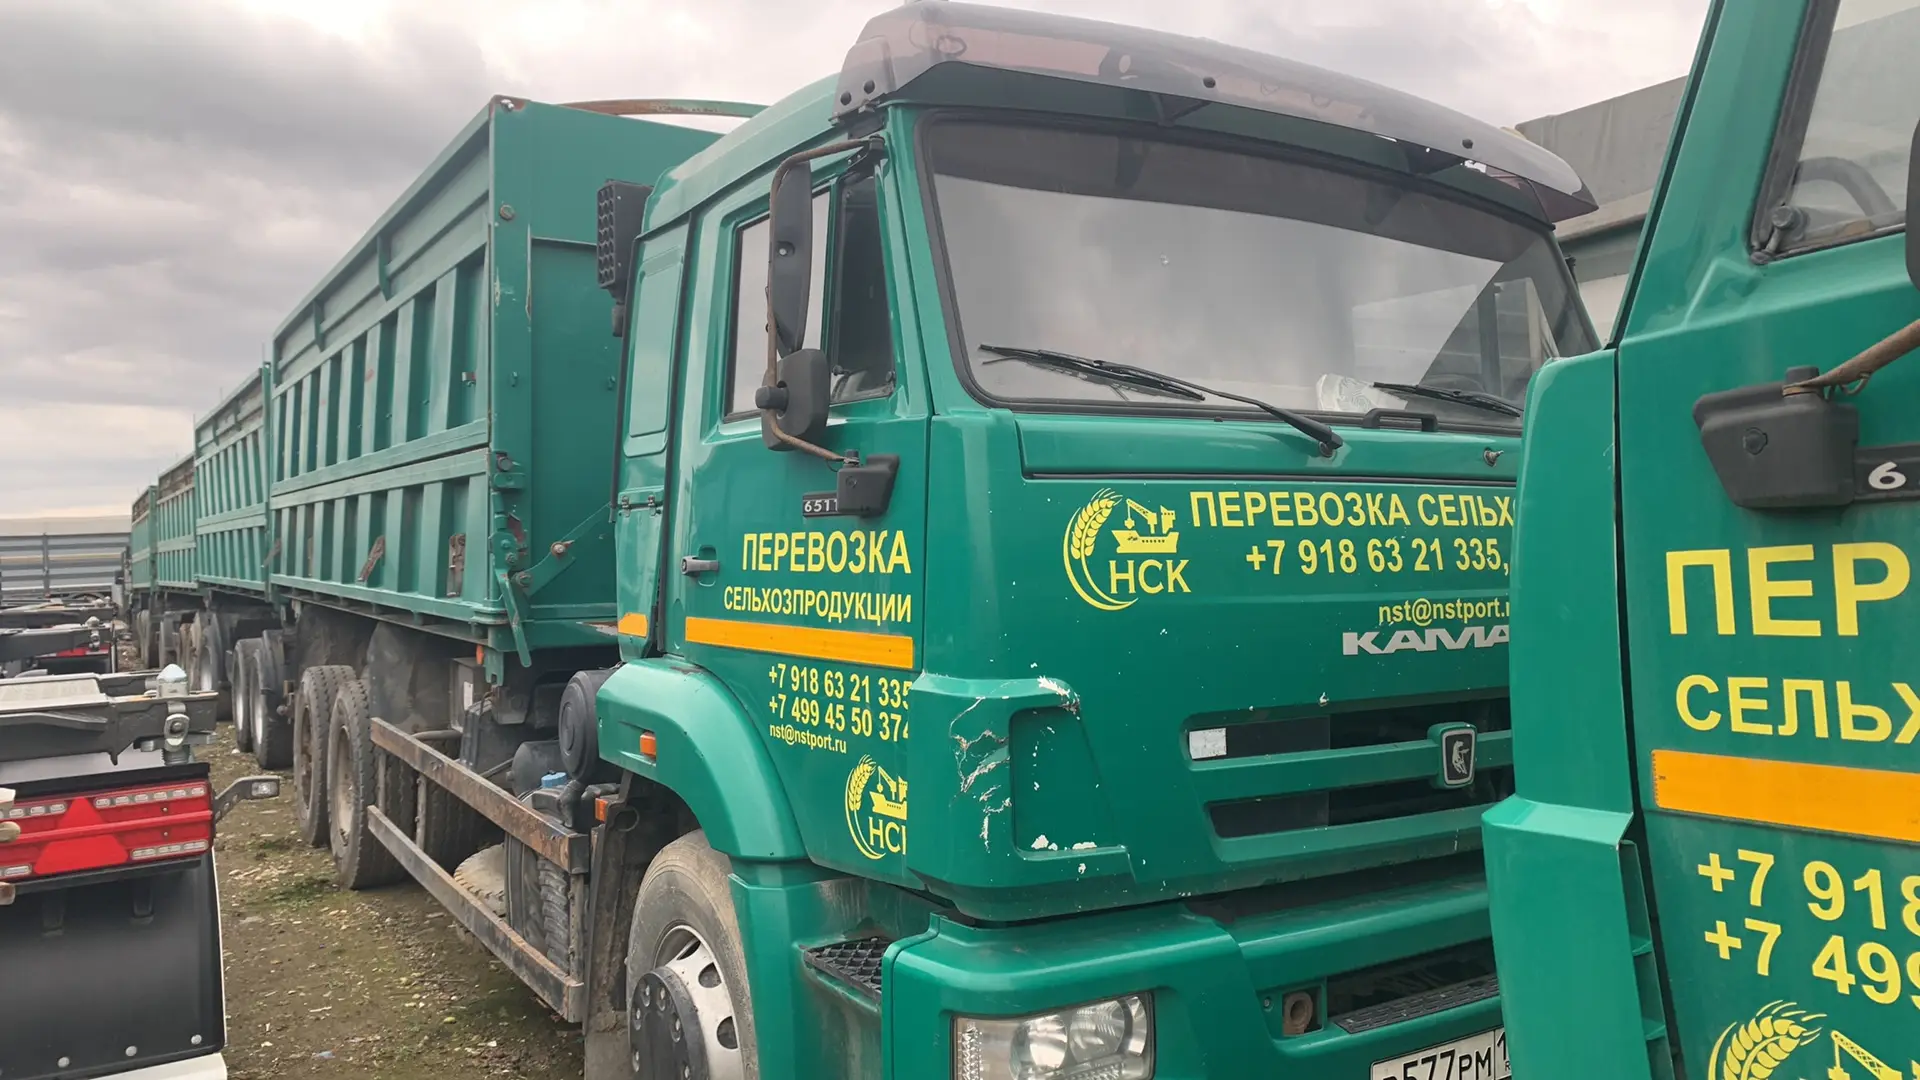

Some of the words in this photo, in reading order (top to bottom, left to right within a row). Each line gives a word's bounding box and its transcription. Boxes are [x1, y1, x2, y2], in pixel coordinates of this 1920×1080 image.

[1190, 491, 1411, 527] ПЕРЕВОЗКА
[1417, 493, 1516, 527] СЕЛЬХ
[742, 530, 912, 574] ПЕРЕВОЗКА
[1246, 539, 1286, 575] +7
[1298, 539, 1358, 575] 918
[1367, 538, 1404, 573] 63
[1411, 537, 1444, 571] 21
[1453, 537, 1509, 576] 335,
[1109, 559, 1192, 594] НСК
[1666, 541, 1911, 637] ПЕР
[724, 585, 912, 627] СЕЛЬХОЗПРОДУКЦИИ
[769, 663, 787, 689] +7
[791, 665, 819, 695] 918
[824, 669, 845, 699] 63
[850, 673, 870, 703] 21
[769, 694, 787, 719] +7
[791, 696, 820, 727] 499
[825, 702, 846, 732] 45
[851, 707, 873, 737] 50
[769, 723, 847, 754] nst@nstport.ru
[1698, 848, 1775, 908] +7
[1704, 917, 1782, 977] +7
